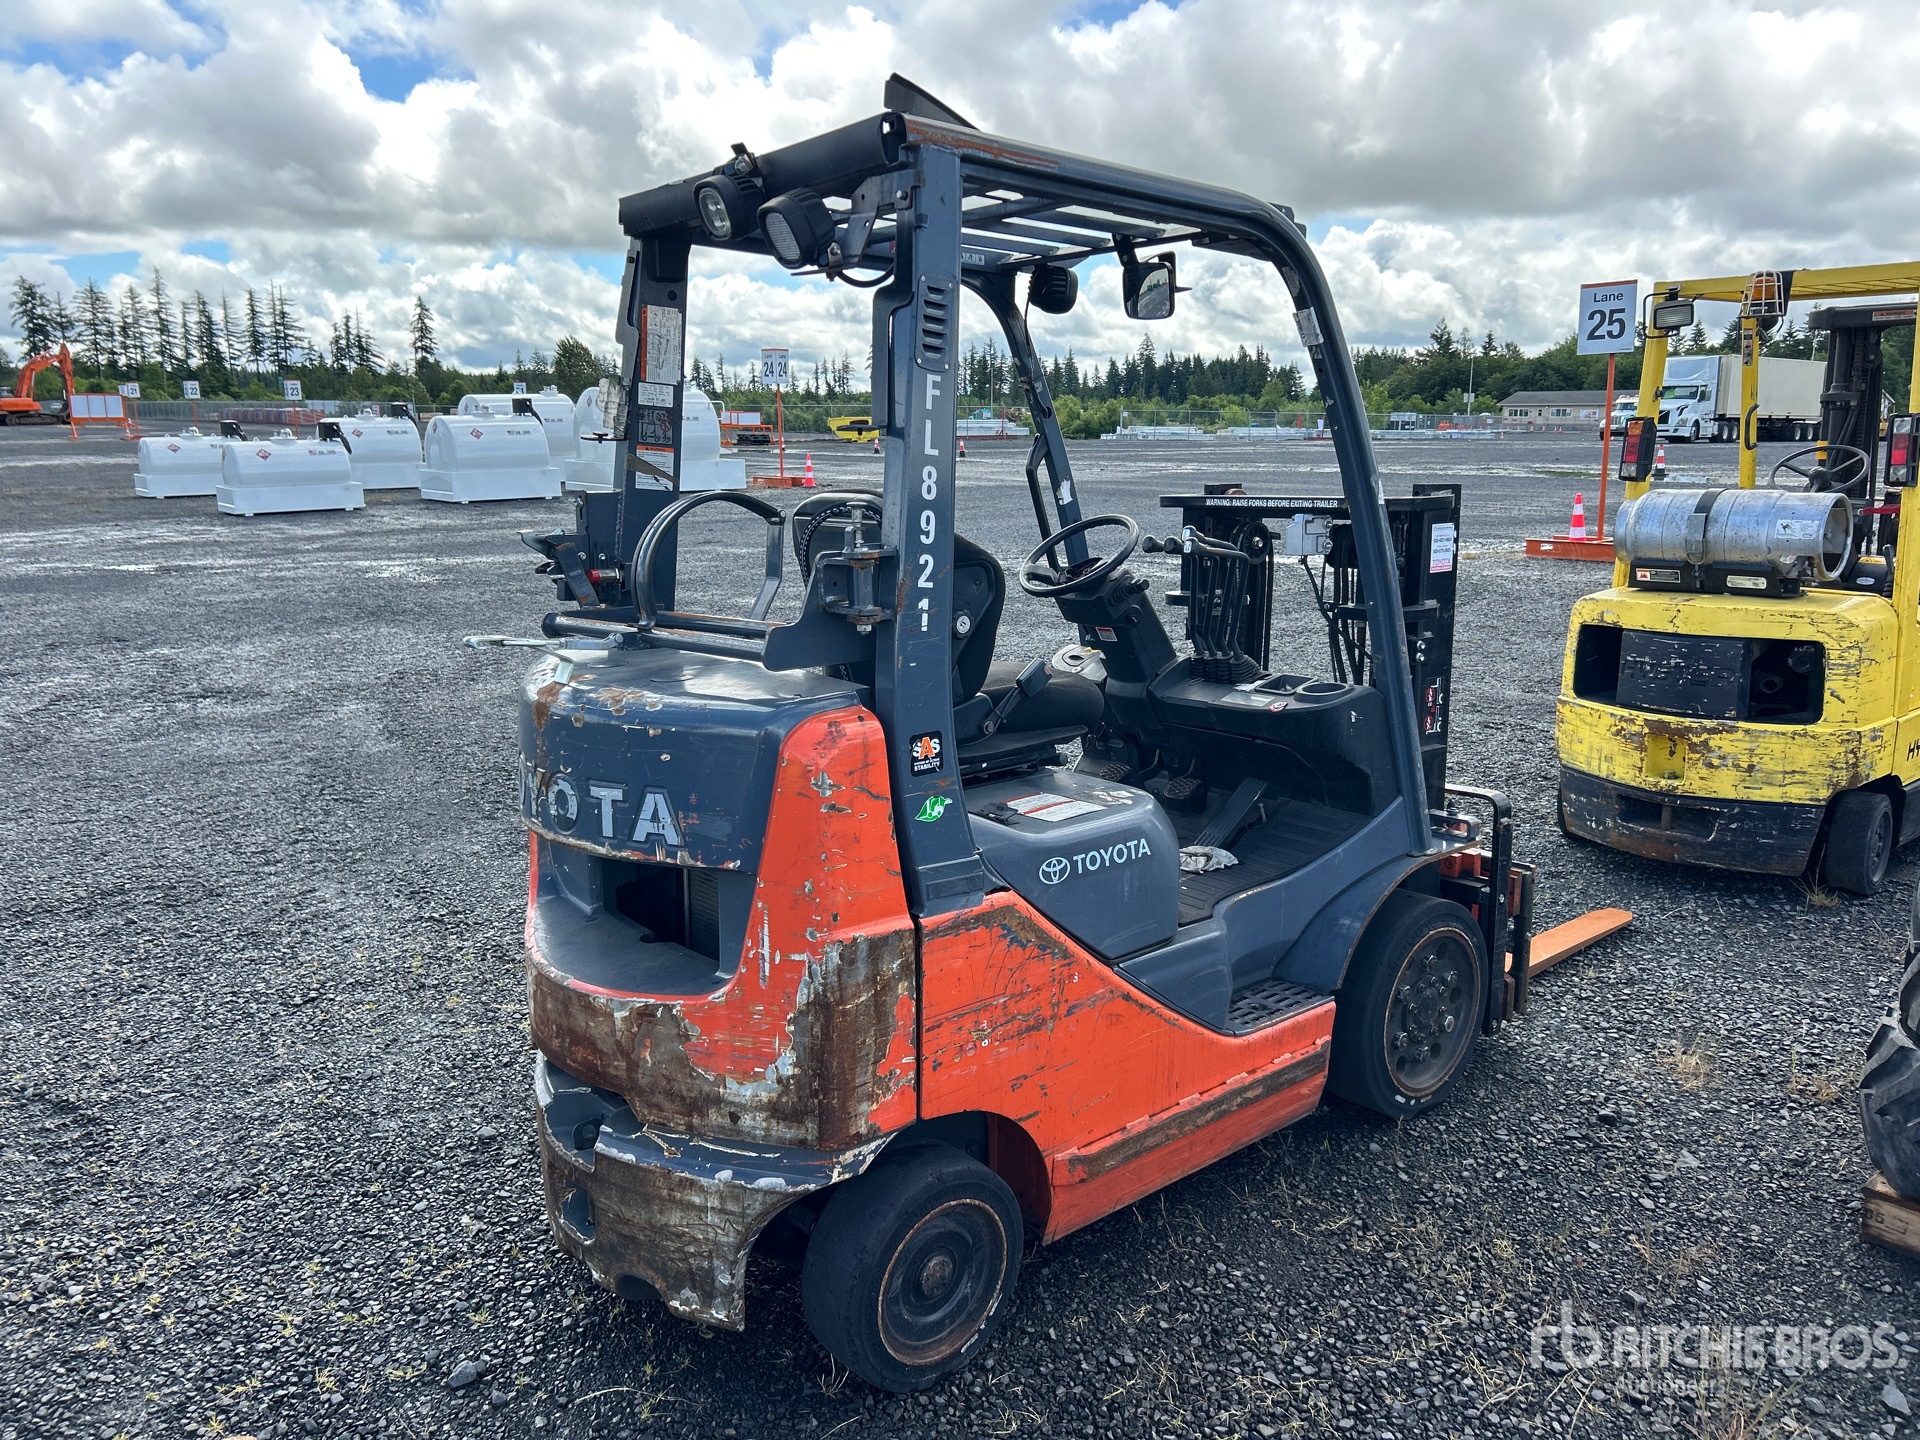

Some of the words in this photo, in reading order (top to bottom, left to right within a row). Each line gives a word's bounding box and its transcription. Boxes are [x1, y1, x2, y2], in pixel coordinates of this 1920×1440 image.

[1593, 292, 1624, 303] Lane
[1586, 307, 1626, 341] 25
[763, 361, 775, 378] 24
[777, 361, 788, 378] 24
[130, 387, 138, 395] 21
[189, 386, 198, 395] 22
[290, 387, 299, 396] 23
[1206, 498, 1232, 506] WARNING:
[1232, 498, 1248, 507] RAISE
[1248, 499, 1267, 507] FORKS
[1267, 499, 1290, 508] BEFORE
[1290, 500, 1313, 508] EXITING
[1313, 500, 1338, 508] TRAILER
[912, 736, 941, 760] SAS
[1072, 837, 1152, 875] TOYOTA
